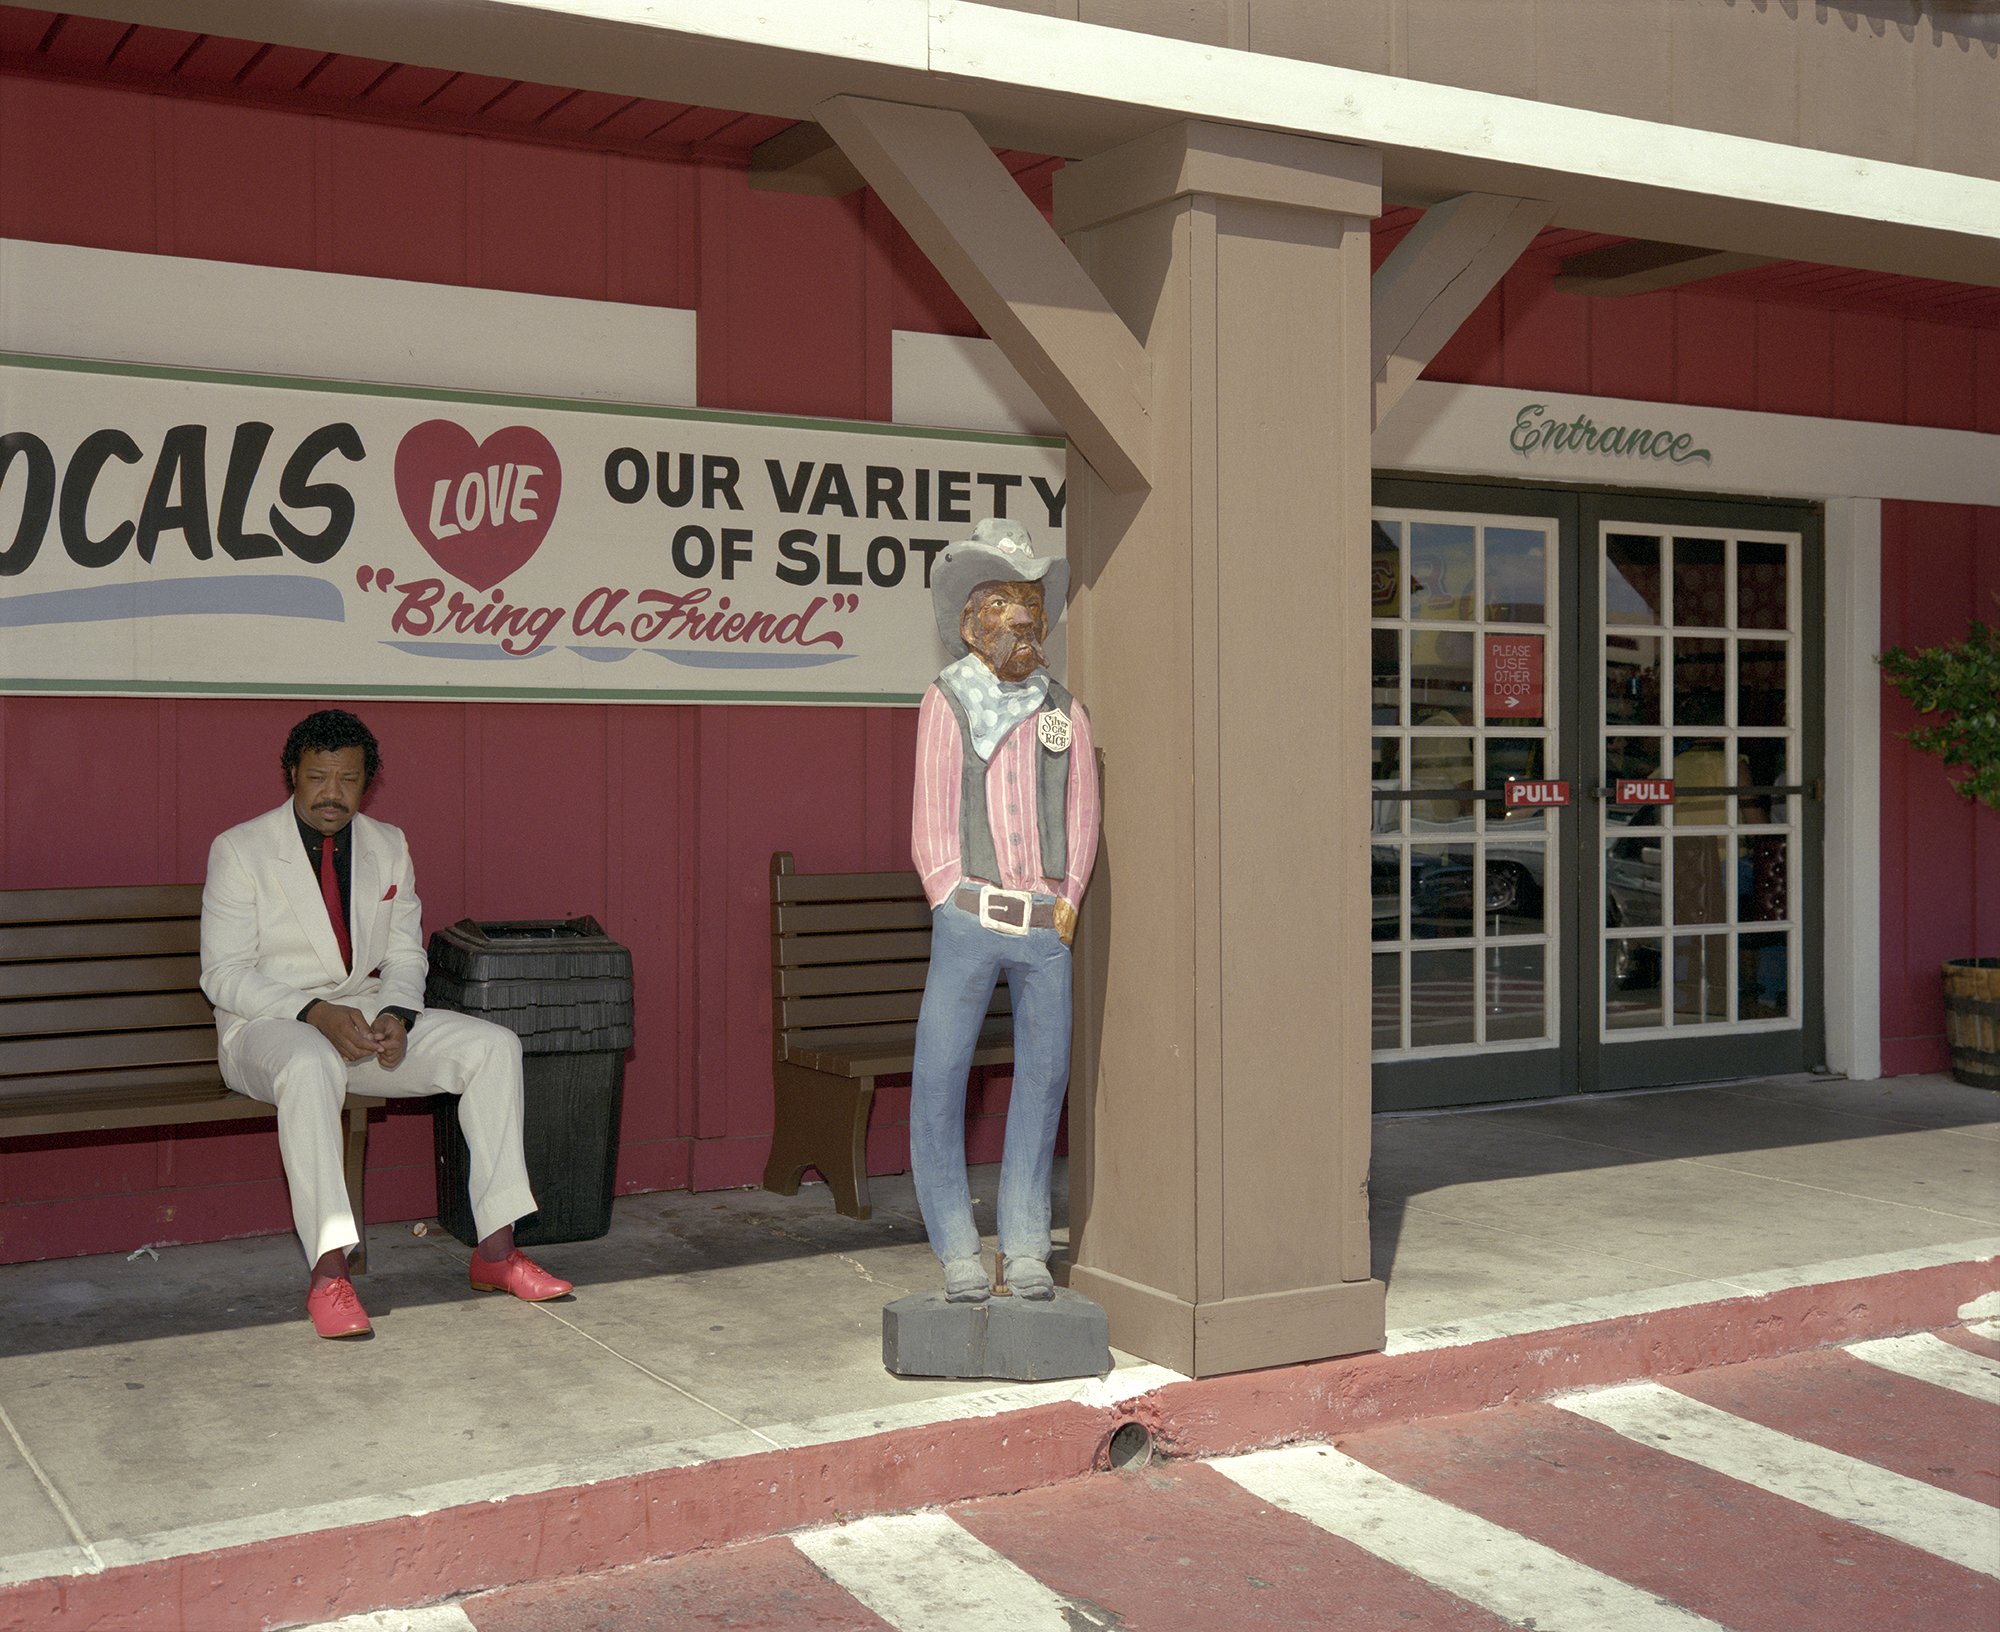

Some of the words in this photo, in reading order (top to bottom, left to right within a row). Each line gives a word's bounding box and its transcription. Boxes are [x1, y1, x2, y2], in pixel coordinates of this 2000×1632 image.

[1510, 404, 1711, 461] Entrance
[604, 447, 744, 511] OUR
[765, 459, 1066, 528] VARIETY
[429, 463, 543, 540] LOVE
[671, 524, 753, 581] OF
[572, 587, 630, 637] A
[1492, 644, 1531, 657] PLEASE
[1495, 657, 1529, 670] USE
[1494, 670, 1530, 682] OTHER
[1493, 683, 1530, 695] DOOR
[1045, 733, 1066, 747] RICH
[1512, 784, 1564, 803] PULL
[1623, 783, 1670, 800] PULL
